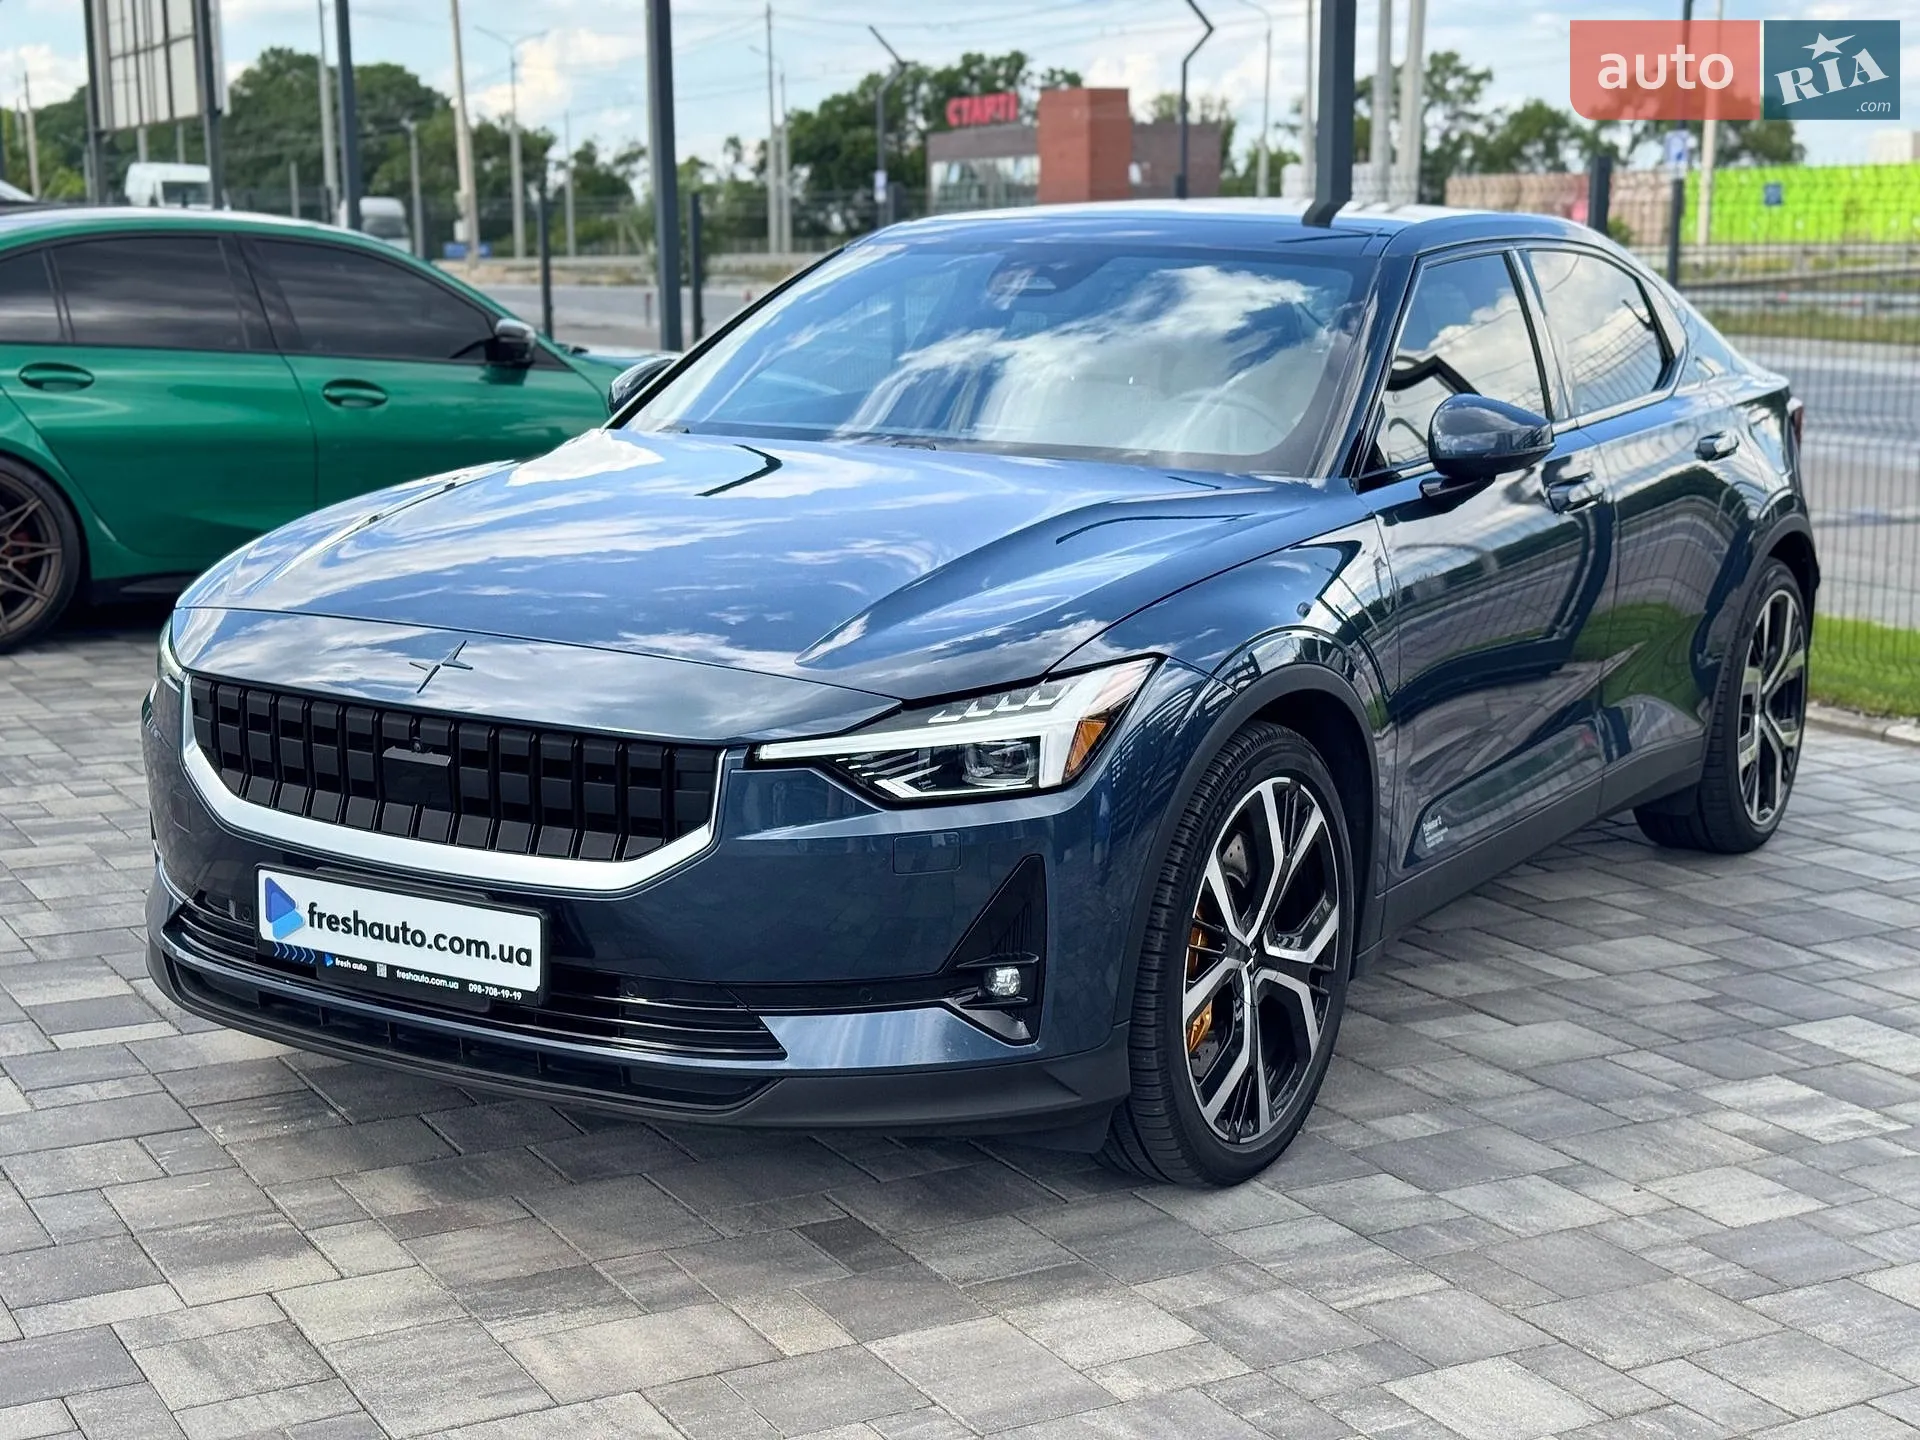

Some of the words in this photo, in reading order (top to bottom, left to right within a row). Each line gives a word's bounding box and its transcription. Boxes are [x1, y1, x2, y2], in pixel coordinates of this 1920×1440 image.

[307, 902, 532, 967] freshauto.com.ua
[335, 957, 351, 969] fresh
[351, 962, 368, 972] auto
[396, 969, 459, 989] freshauto.com.ua
[468, 983, 522, 1000] 098-708-19-19
